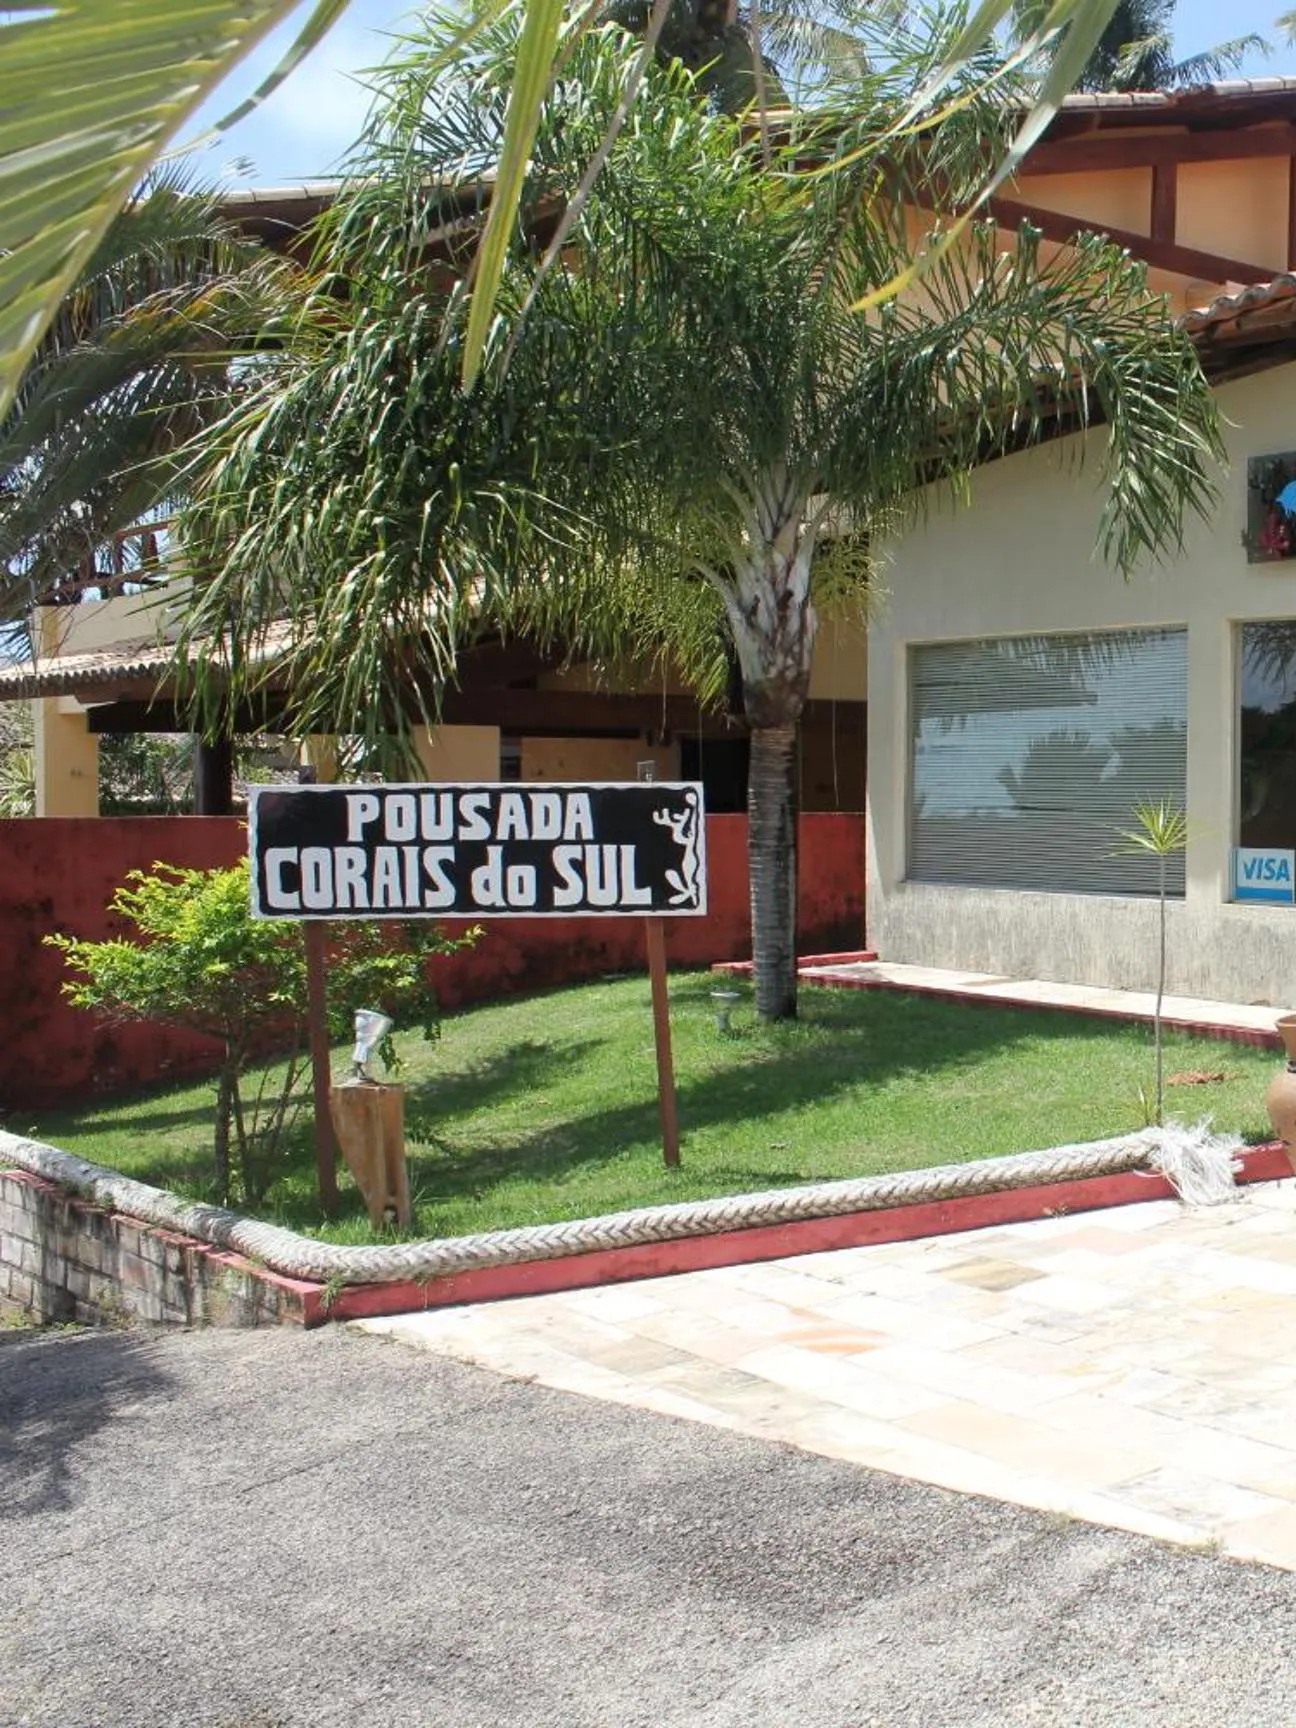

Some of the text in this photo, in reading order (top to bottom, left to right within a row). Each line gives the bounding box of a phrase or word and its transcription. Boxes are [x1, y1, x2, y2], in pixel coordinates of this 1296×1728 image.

[345, 792, 595, 842] POUSADA
[263, 845, 652, 909] CORAIS do SUL
[1243, 857, 1290, 882] VISA
